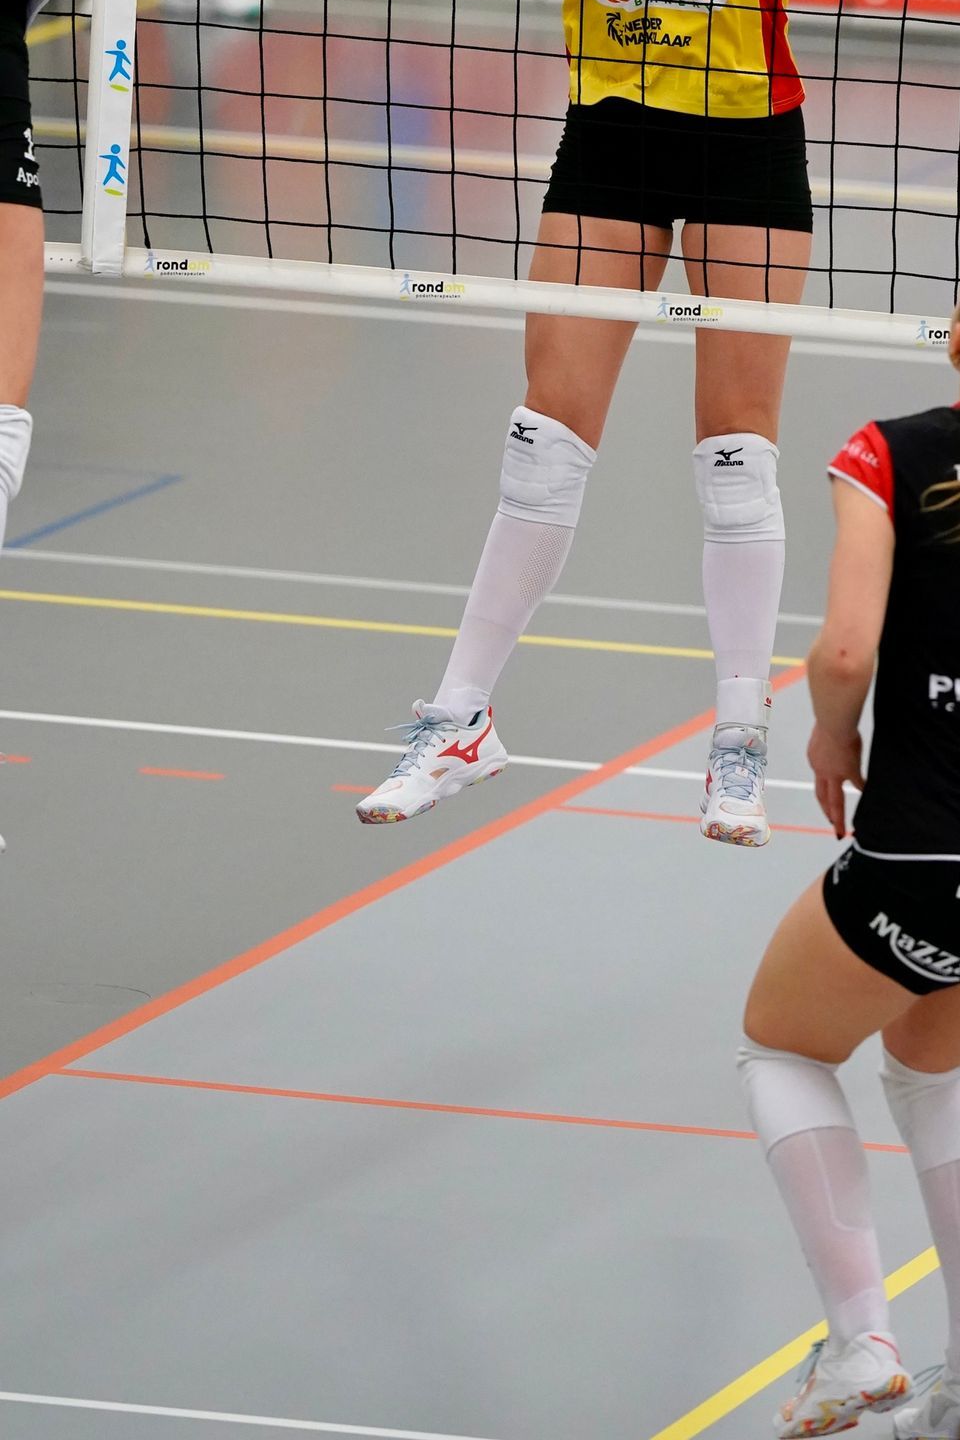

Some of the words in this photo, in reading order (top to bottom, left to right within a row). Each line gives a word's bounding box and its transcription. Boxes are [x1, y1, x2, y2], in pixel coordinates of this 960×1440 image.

[624, 30, 692, 48] MAKLAAR
[156, 259, 211, 271] rondom
[412, 281, 465, 293] rondom
[669, 304, 723, 317] rondom
